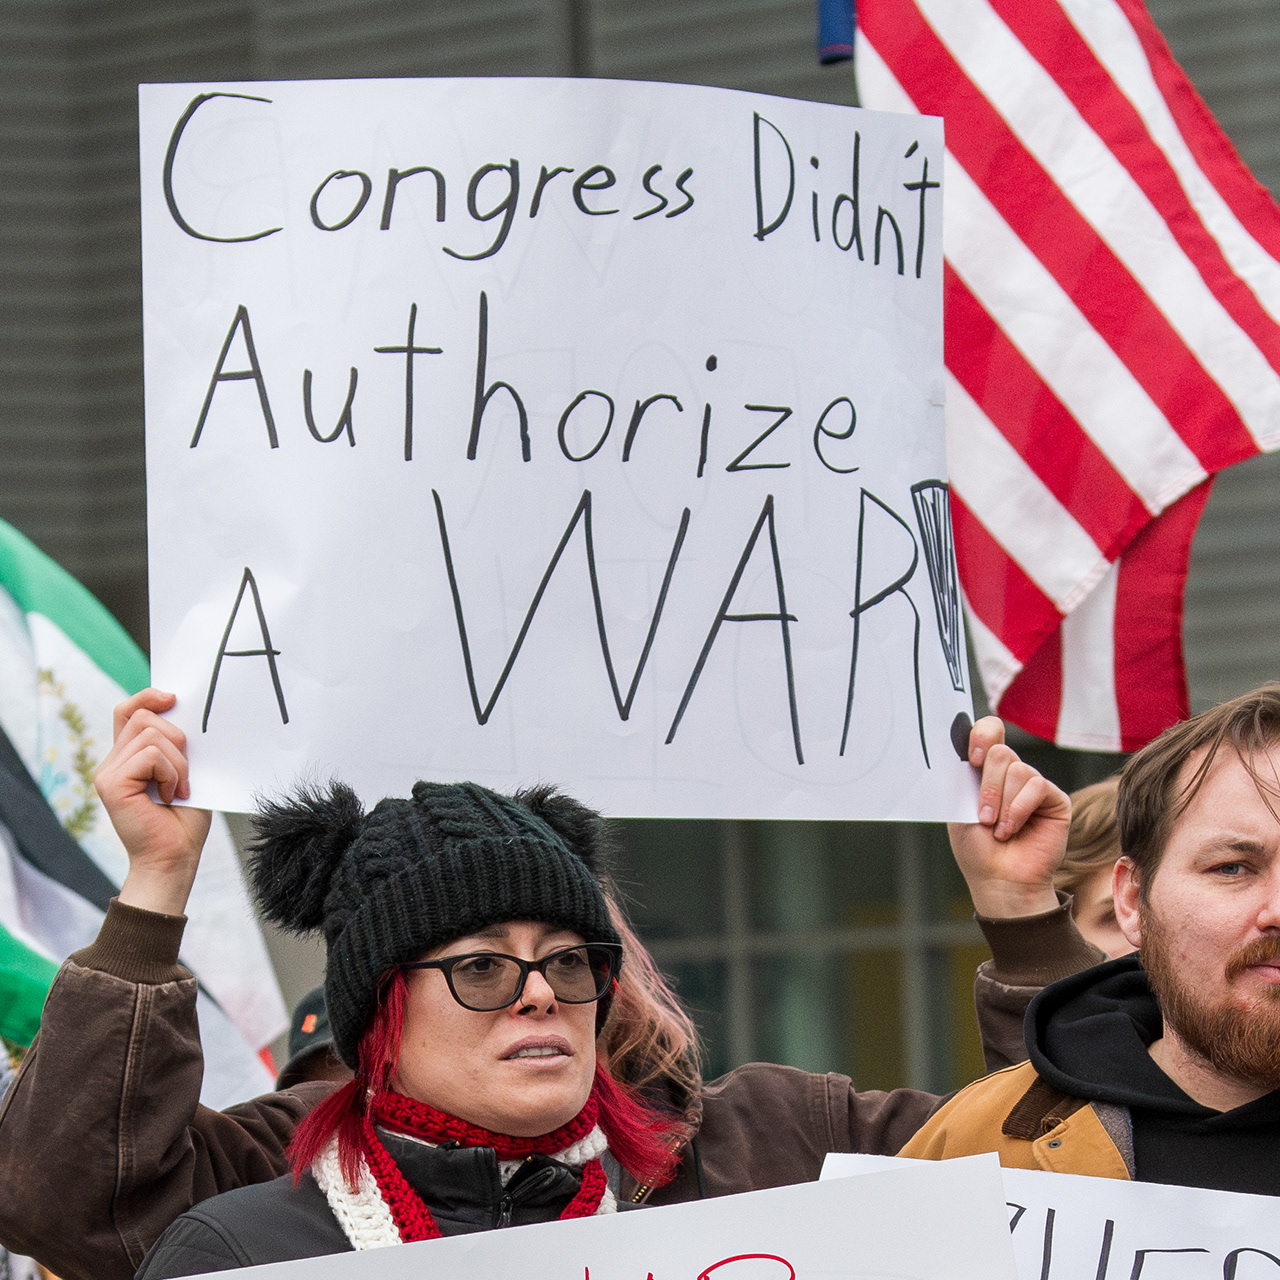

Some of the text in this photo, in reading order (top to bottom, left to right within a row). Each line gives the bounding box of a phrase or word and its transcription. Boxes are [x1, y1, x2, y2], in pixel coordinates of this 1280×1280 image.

[162, 92, 942, 280] Congress Didn't
[190, 290, 861, 475] Authorize
[202, 478, 974, 771] A WAR!
